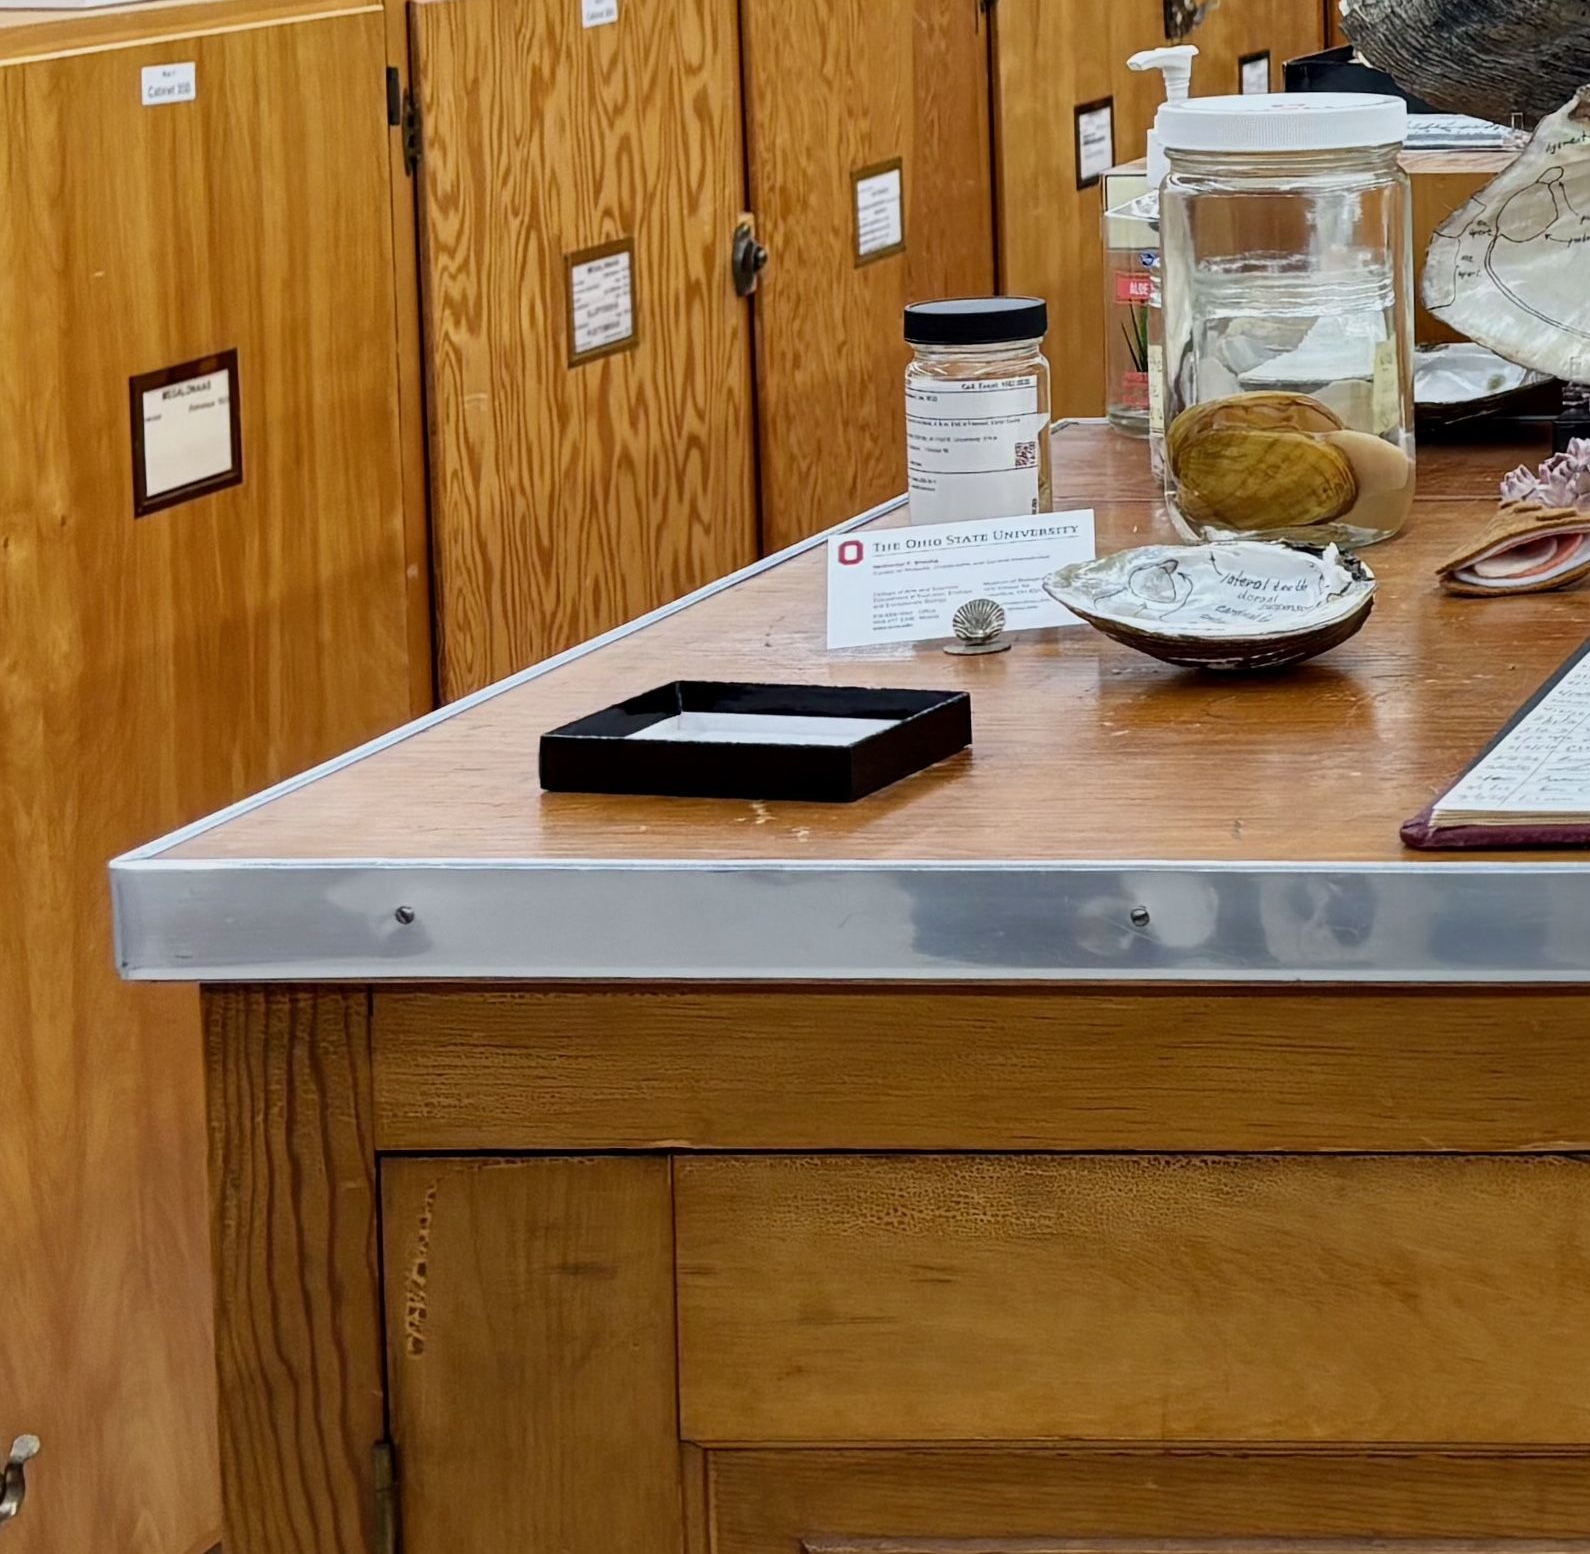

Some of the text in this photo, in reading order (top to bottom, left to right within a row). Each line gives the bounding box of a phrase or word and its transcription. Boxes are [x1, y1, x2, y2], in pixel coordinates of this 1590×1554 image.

[872, 524, 1080, 553] THE OHIO STATE UNIVERSITY
